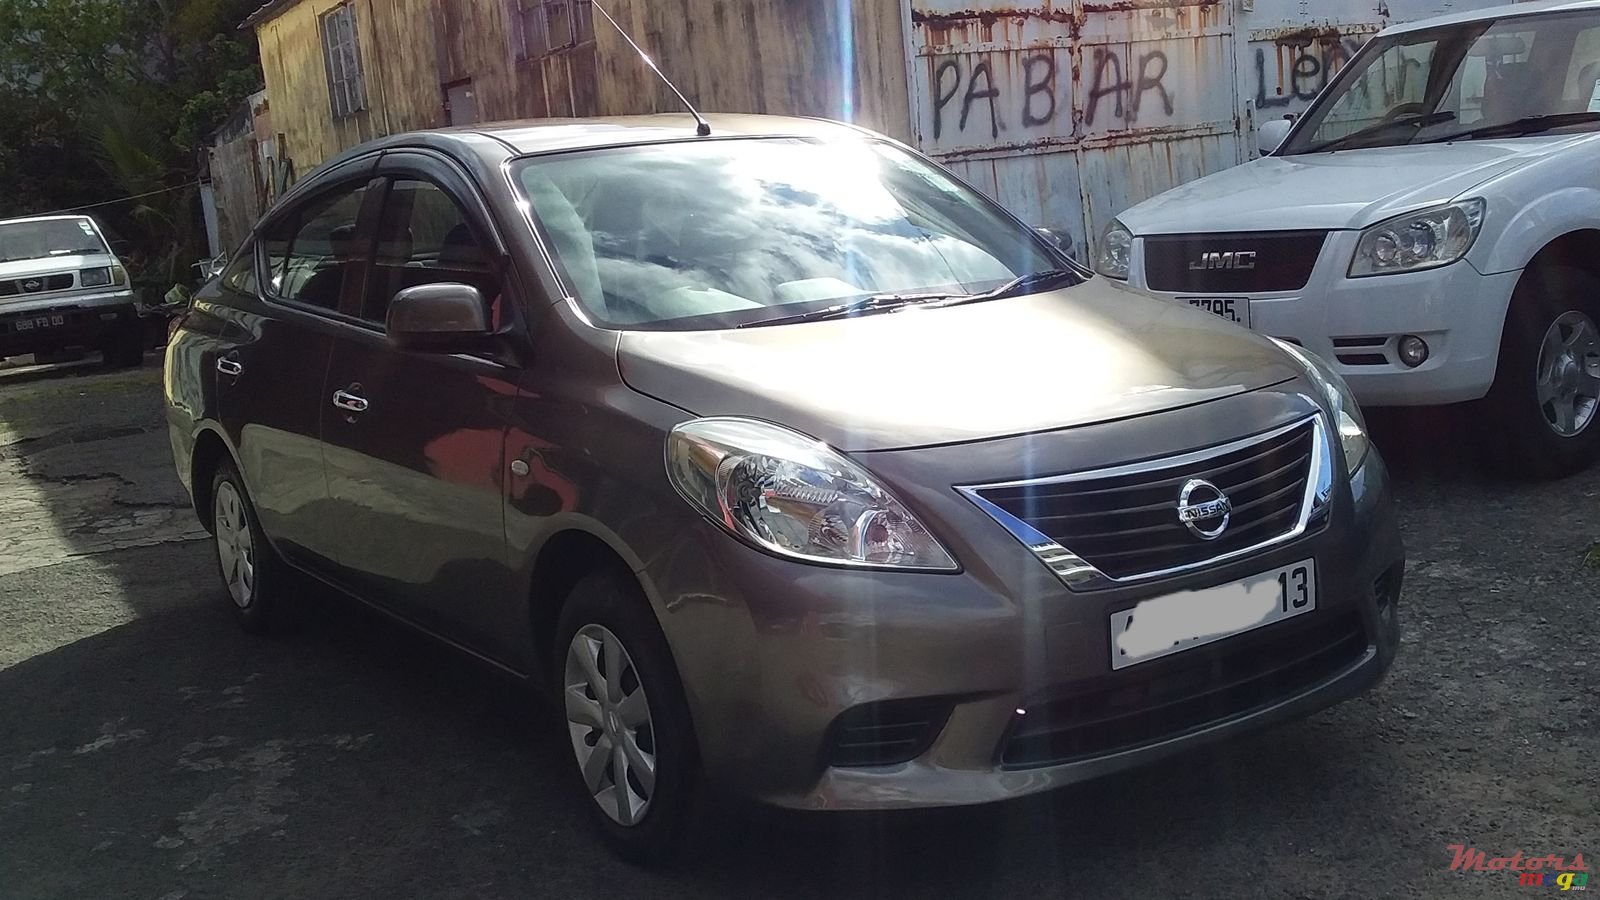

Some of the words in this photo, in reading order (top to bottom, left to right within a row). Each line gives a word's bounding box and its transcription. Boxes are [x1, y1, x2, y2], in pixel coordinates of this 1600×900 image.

[1188, 251, 1257, 270] JMC
[1183, 498, 1230, 519] NISSAN
[1277, 566, 1308, 613] 13
